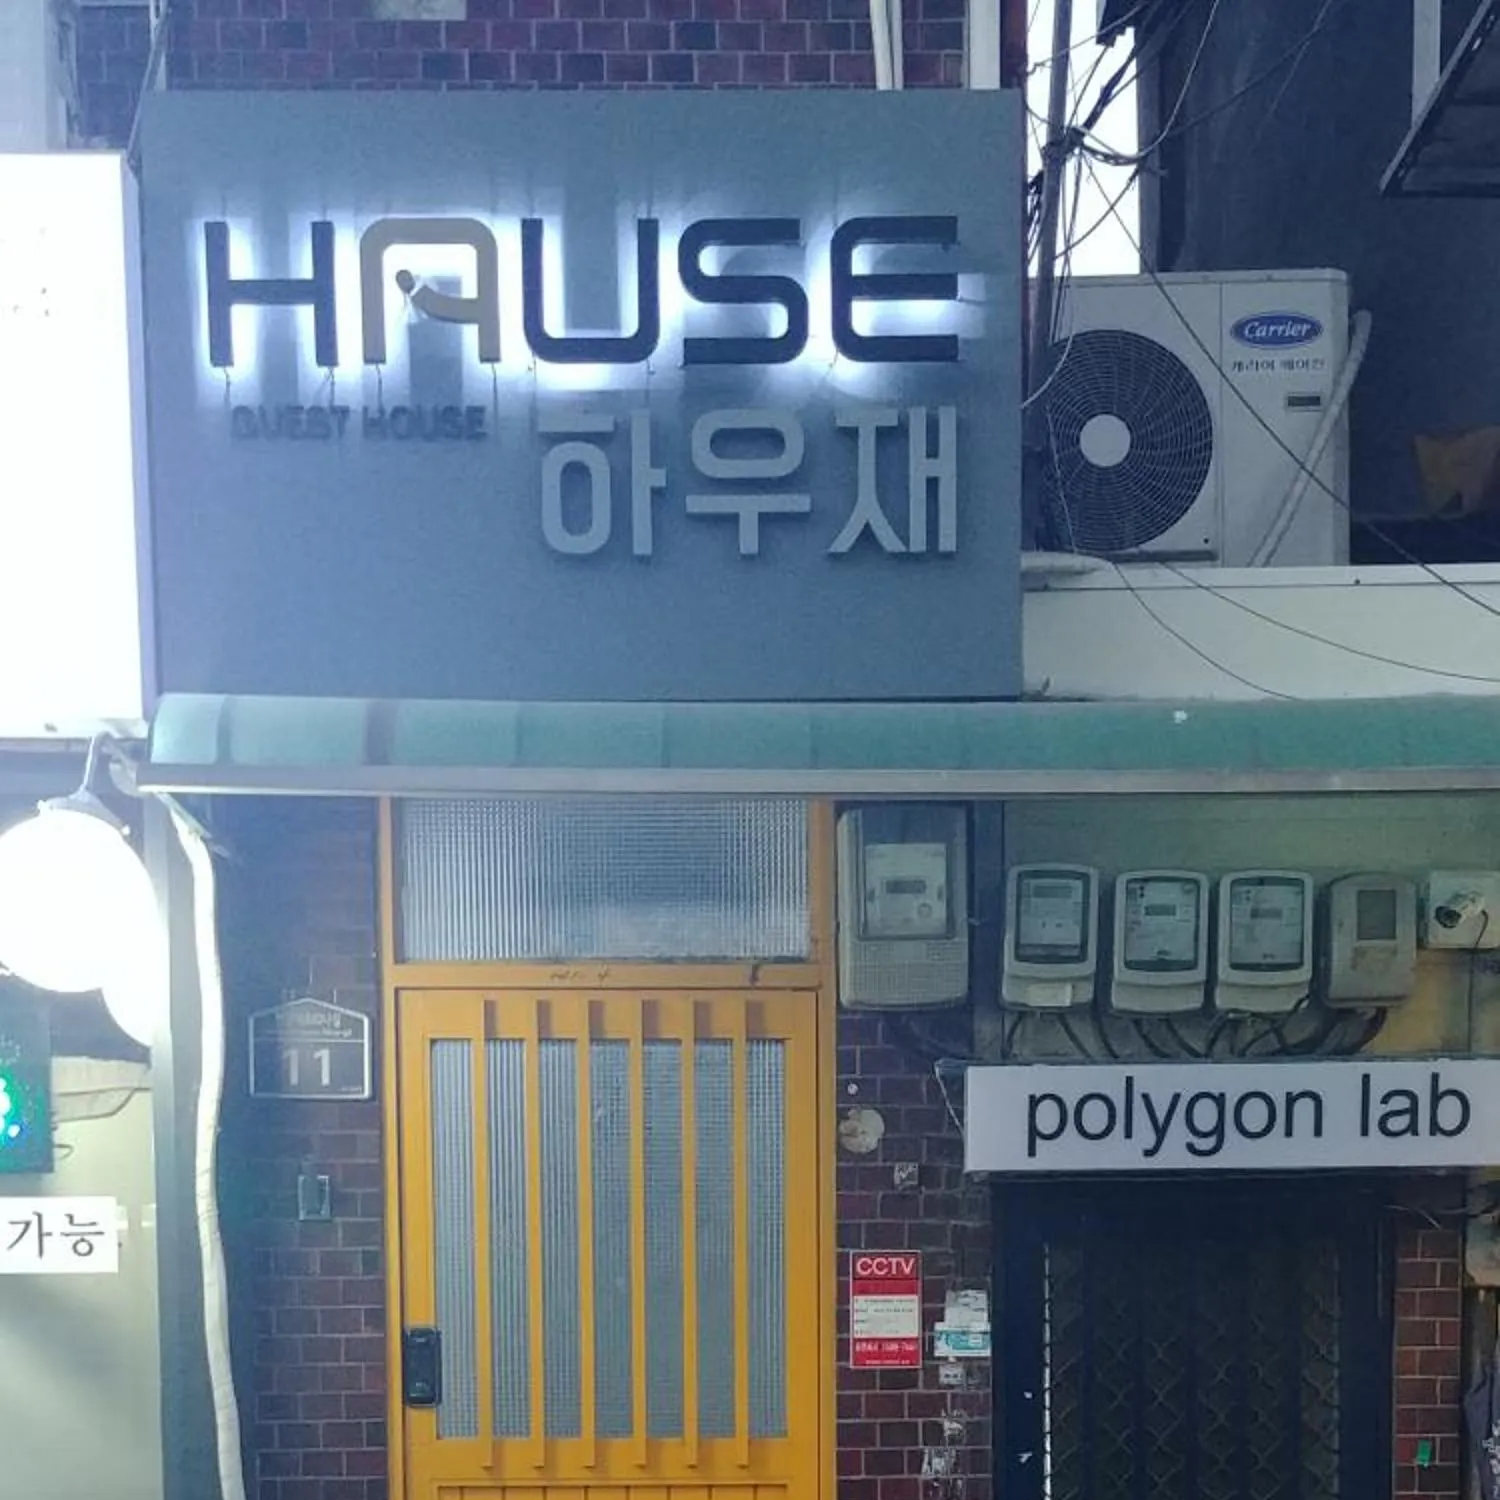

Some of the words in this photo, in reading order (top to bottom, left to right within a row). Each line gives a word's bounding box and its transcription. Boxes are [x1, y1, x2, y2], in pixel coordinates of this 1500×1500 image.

[203, 216, 959, 368] HAUSE
[1243, 320, 1312, 338] Carrier
[231, 405, 350, 440] GUEST
[361, 405, 487, 440] HOUSE
[538, 405, 958, 560] 하우재
[282, 1049, 331, 1087] 11
[1026, 1076, 1323, 1158] polygon
[1361, 1073, 1472, 1138] lab
[6, 1210, 105, 1260] 가능
[856, 1257, 915, 1275] CCTV
